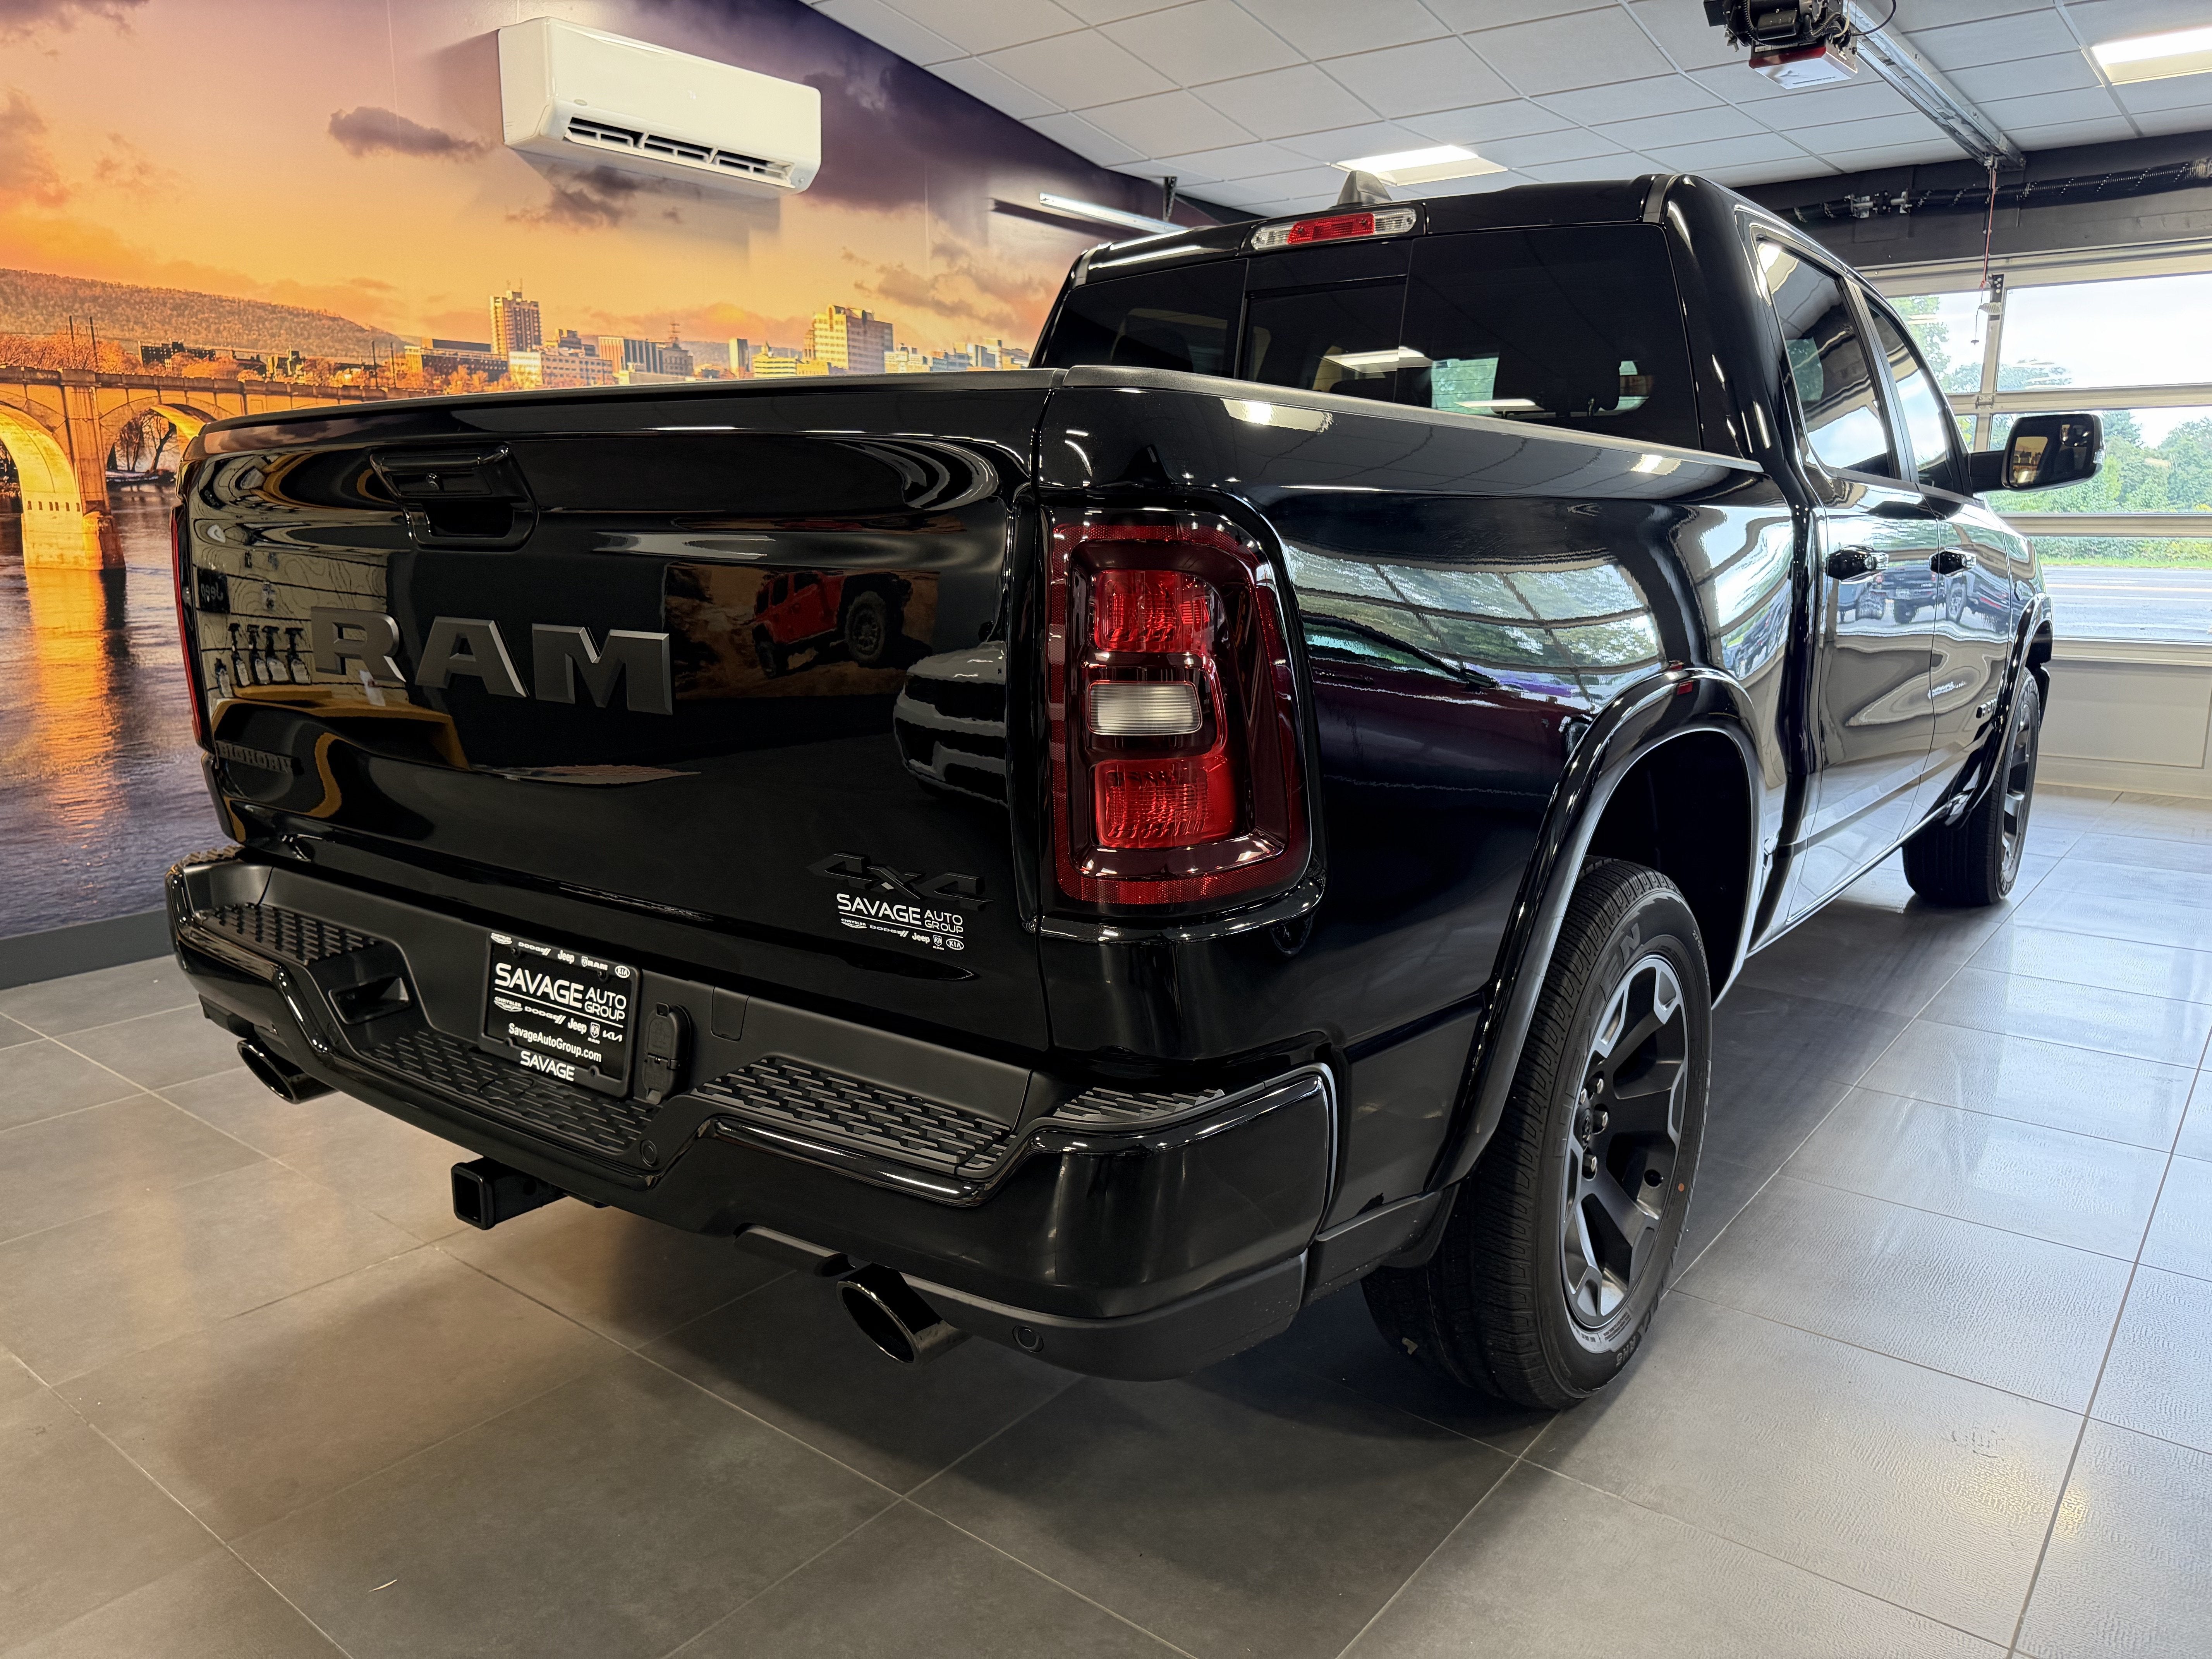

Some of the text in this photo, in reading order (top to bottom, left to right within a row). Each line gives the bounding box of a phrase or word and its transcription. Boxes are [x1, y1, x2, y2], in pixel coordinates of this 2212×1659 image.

[310, 606, 673, 716] RAM
[836, 893, 963, 925] SAVAGE AUTO
[841, 918, 866, 926] CHRYSLER
[912, 932, 930, 944] Jeep
[949, 940, 962, 948] KIA
[924, 920, 963, 934] GROUP
[518, 941, 547, 954] DODGE
[558, 950, 575, 964] Jeep
[587, 960, 608, 971] RAM
[495, 963, 627, 1010] SAVAGE AUTO
[494, 996, 522, 1007] CHRYSLER
[524, 1006, 560, 1022] DODGE
[567, 1018, 587, 1035] Jeep
[584, 1001, 625, 1021] GROUP
[508, 1023, 602, 1063] SavageAutoGroup.com
[520, 1050, 575, 1082] SAVAGE
